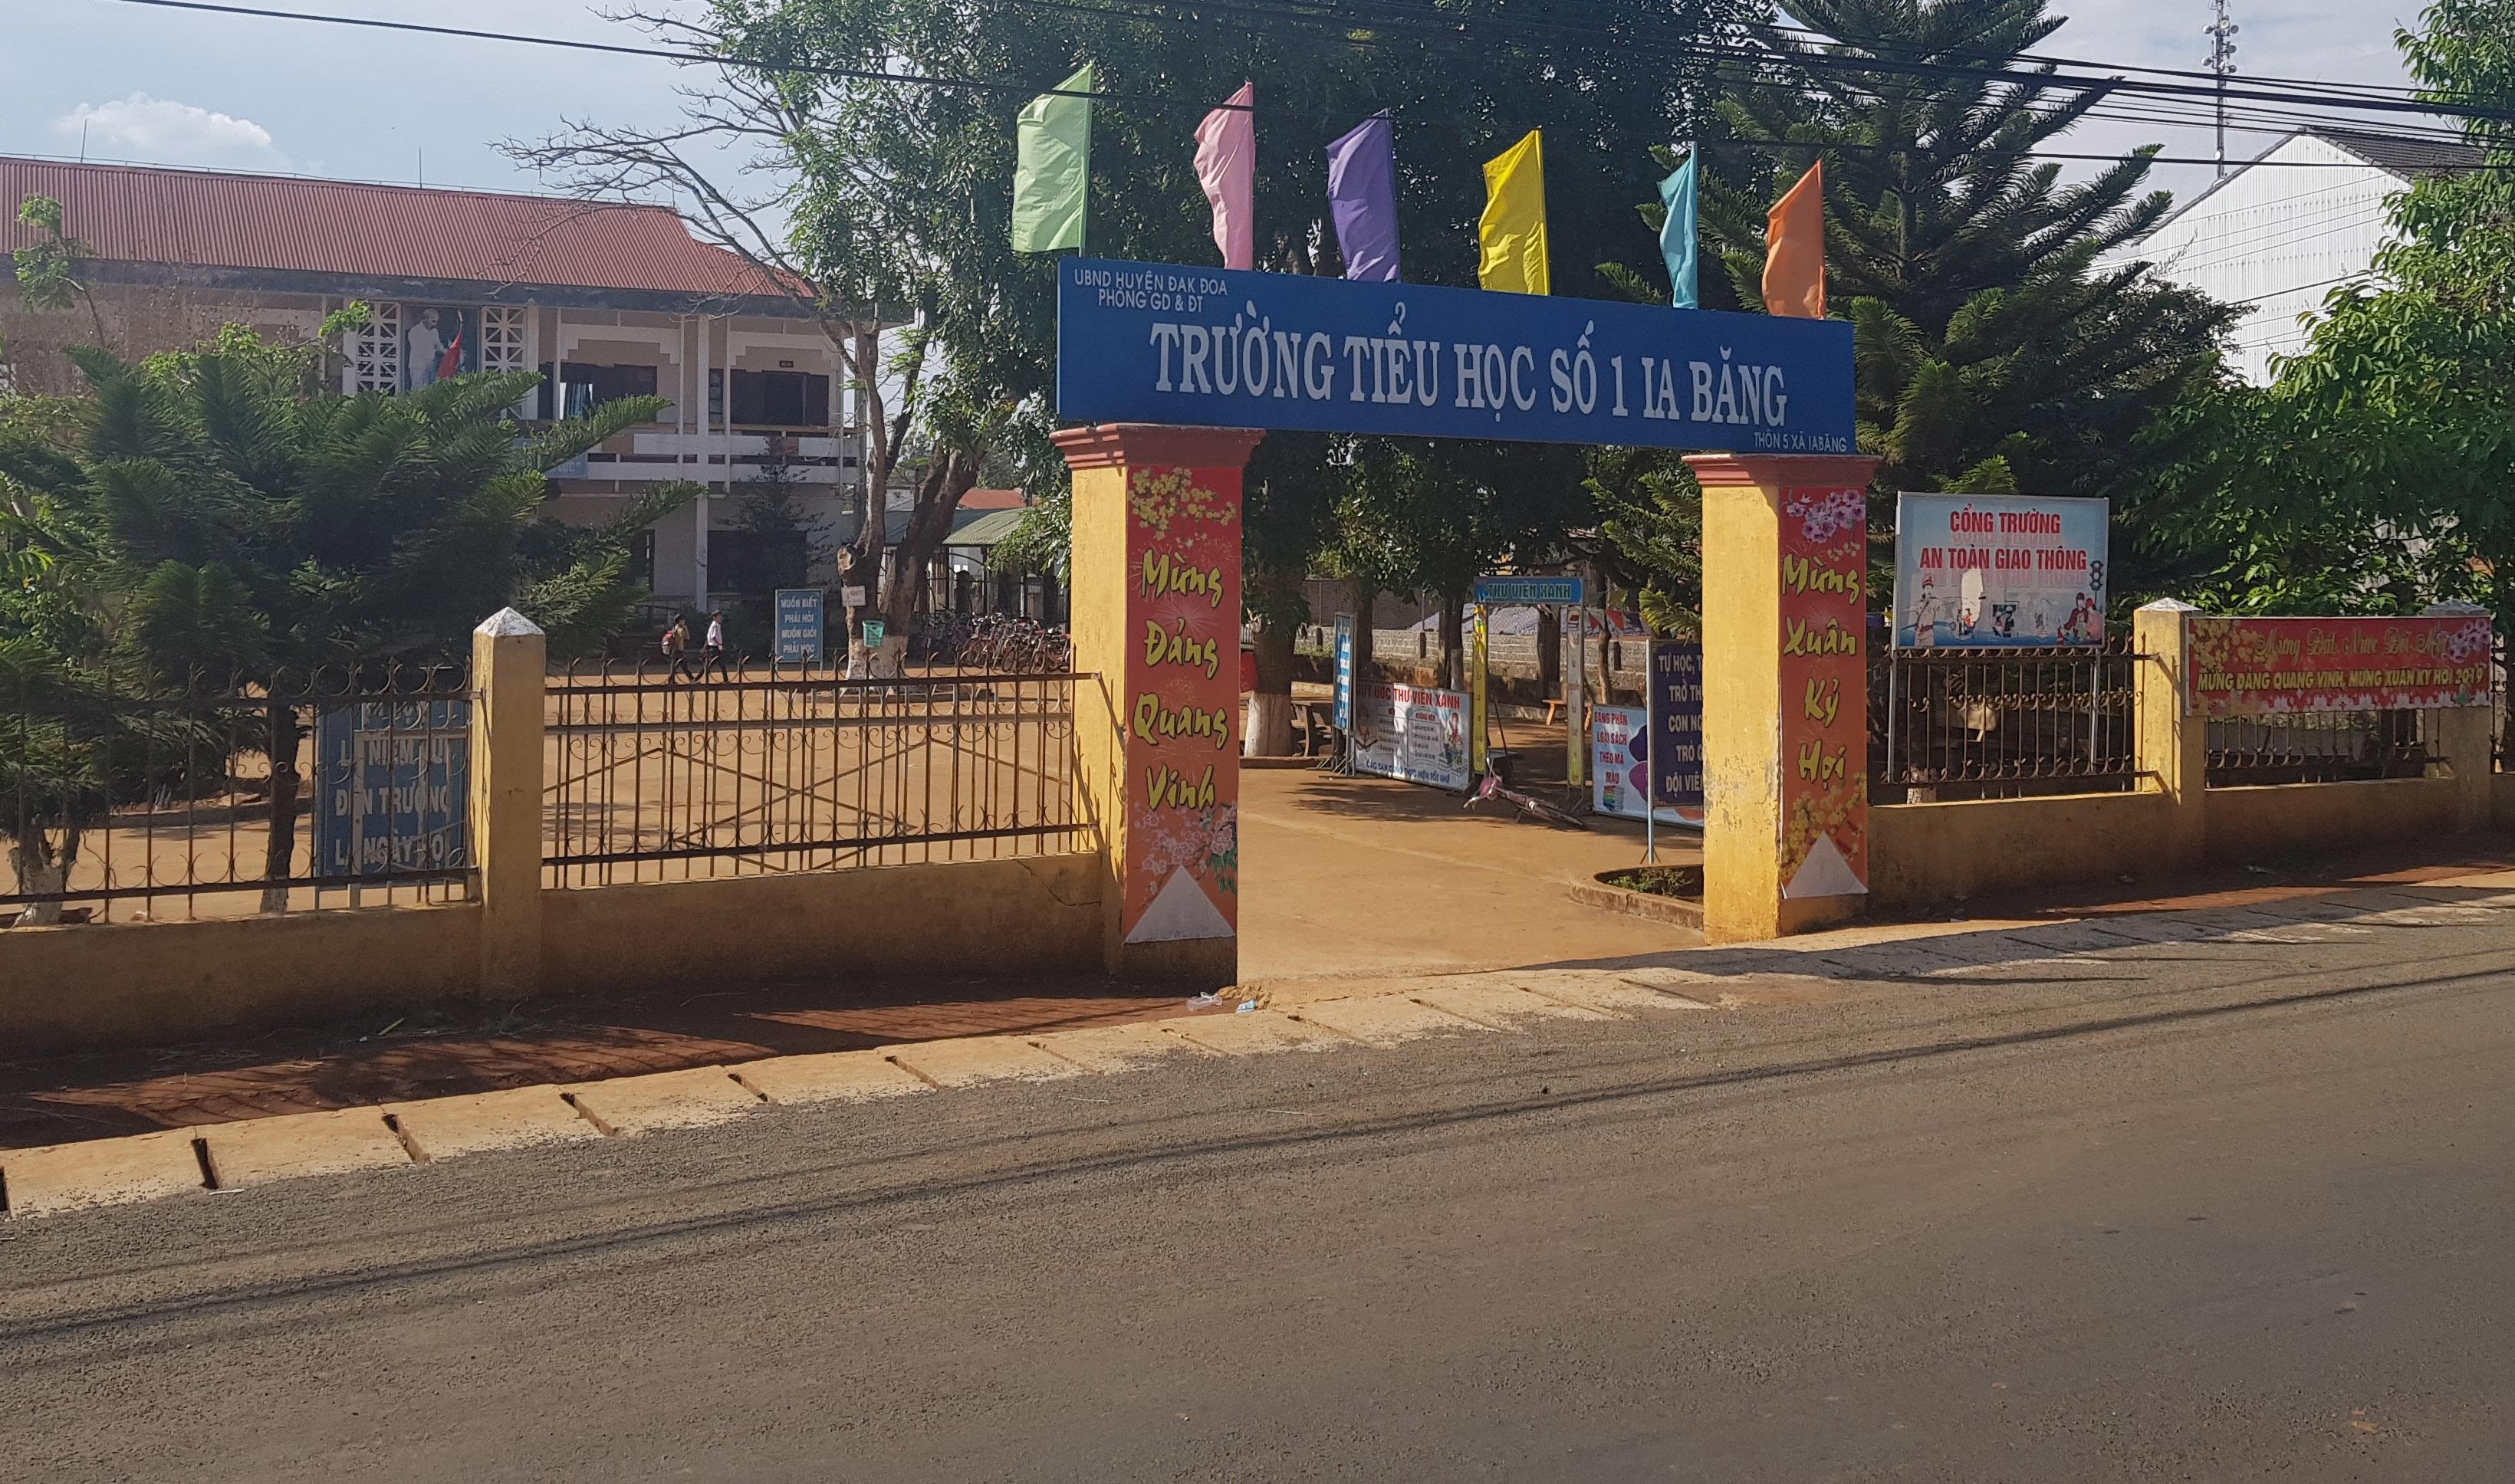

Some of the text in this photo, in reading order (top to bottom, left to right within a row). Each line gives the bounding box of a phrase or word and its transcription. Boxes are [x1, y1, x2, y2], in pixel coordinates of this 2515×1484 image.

[1074, 268, 1228, 296] UBND HUYỆN ĐAK ĐOA
[1098, 284, 1204, 313] PHÒNG GD & ĐT
[1149, 300, 1787, 427] TRƯỜNG TIỂU HỌC SỐ 1 IA BĂNG
[1754, 429, 1780, 449] THÔN
[1783, 434, 1789, 449] 5
[1791, 431, 1806, 450] XÃ
[1950, 503, 2061, 534] CỔNG TRƯỜNG
[1920, 543, 2087, 570] AN TOÀN GIAO THÔNG
[1141, 548, 1224, 608] Mừng
[1540, 583, 1572, 599] XANH
[1781, 553, 1861, 606] Mừng
[781, 596, 818, 608] MUỐN BIẾT
[784, 611, 801, 623] PHẢI
[781, 626, 801, 639] MUỐN
[1783, 615, 1857, 657] Xuân
[1143, 617, 1220, 679] Đảng
[1659, 652, 1671, 677] TỰ
[2273, 671, 2314, 690] QUANG
[1393, 688, 1411, 702] THƯ
[1435, 693, 1461, 710] XANH
[1804, 677, 1840, 728] Kỷ
[1133, 692, 1228, 750] Quang
[1668, 714, 1688, 733] CON
[1611, 731, 1627, 746] SÁCH
[1676, 740, 1695, 762] TRÒ
[1599, 751, 1613, 764] THEO
[1797, 739, 1847, 790] Hợi
[1146, 763, 1216, 811] Vinh
[335, 788, 373, 816] ĐN
